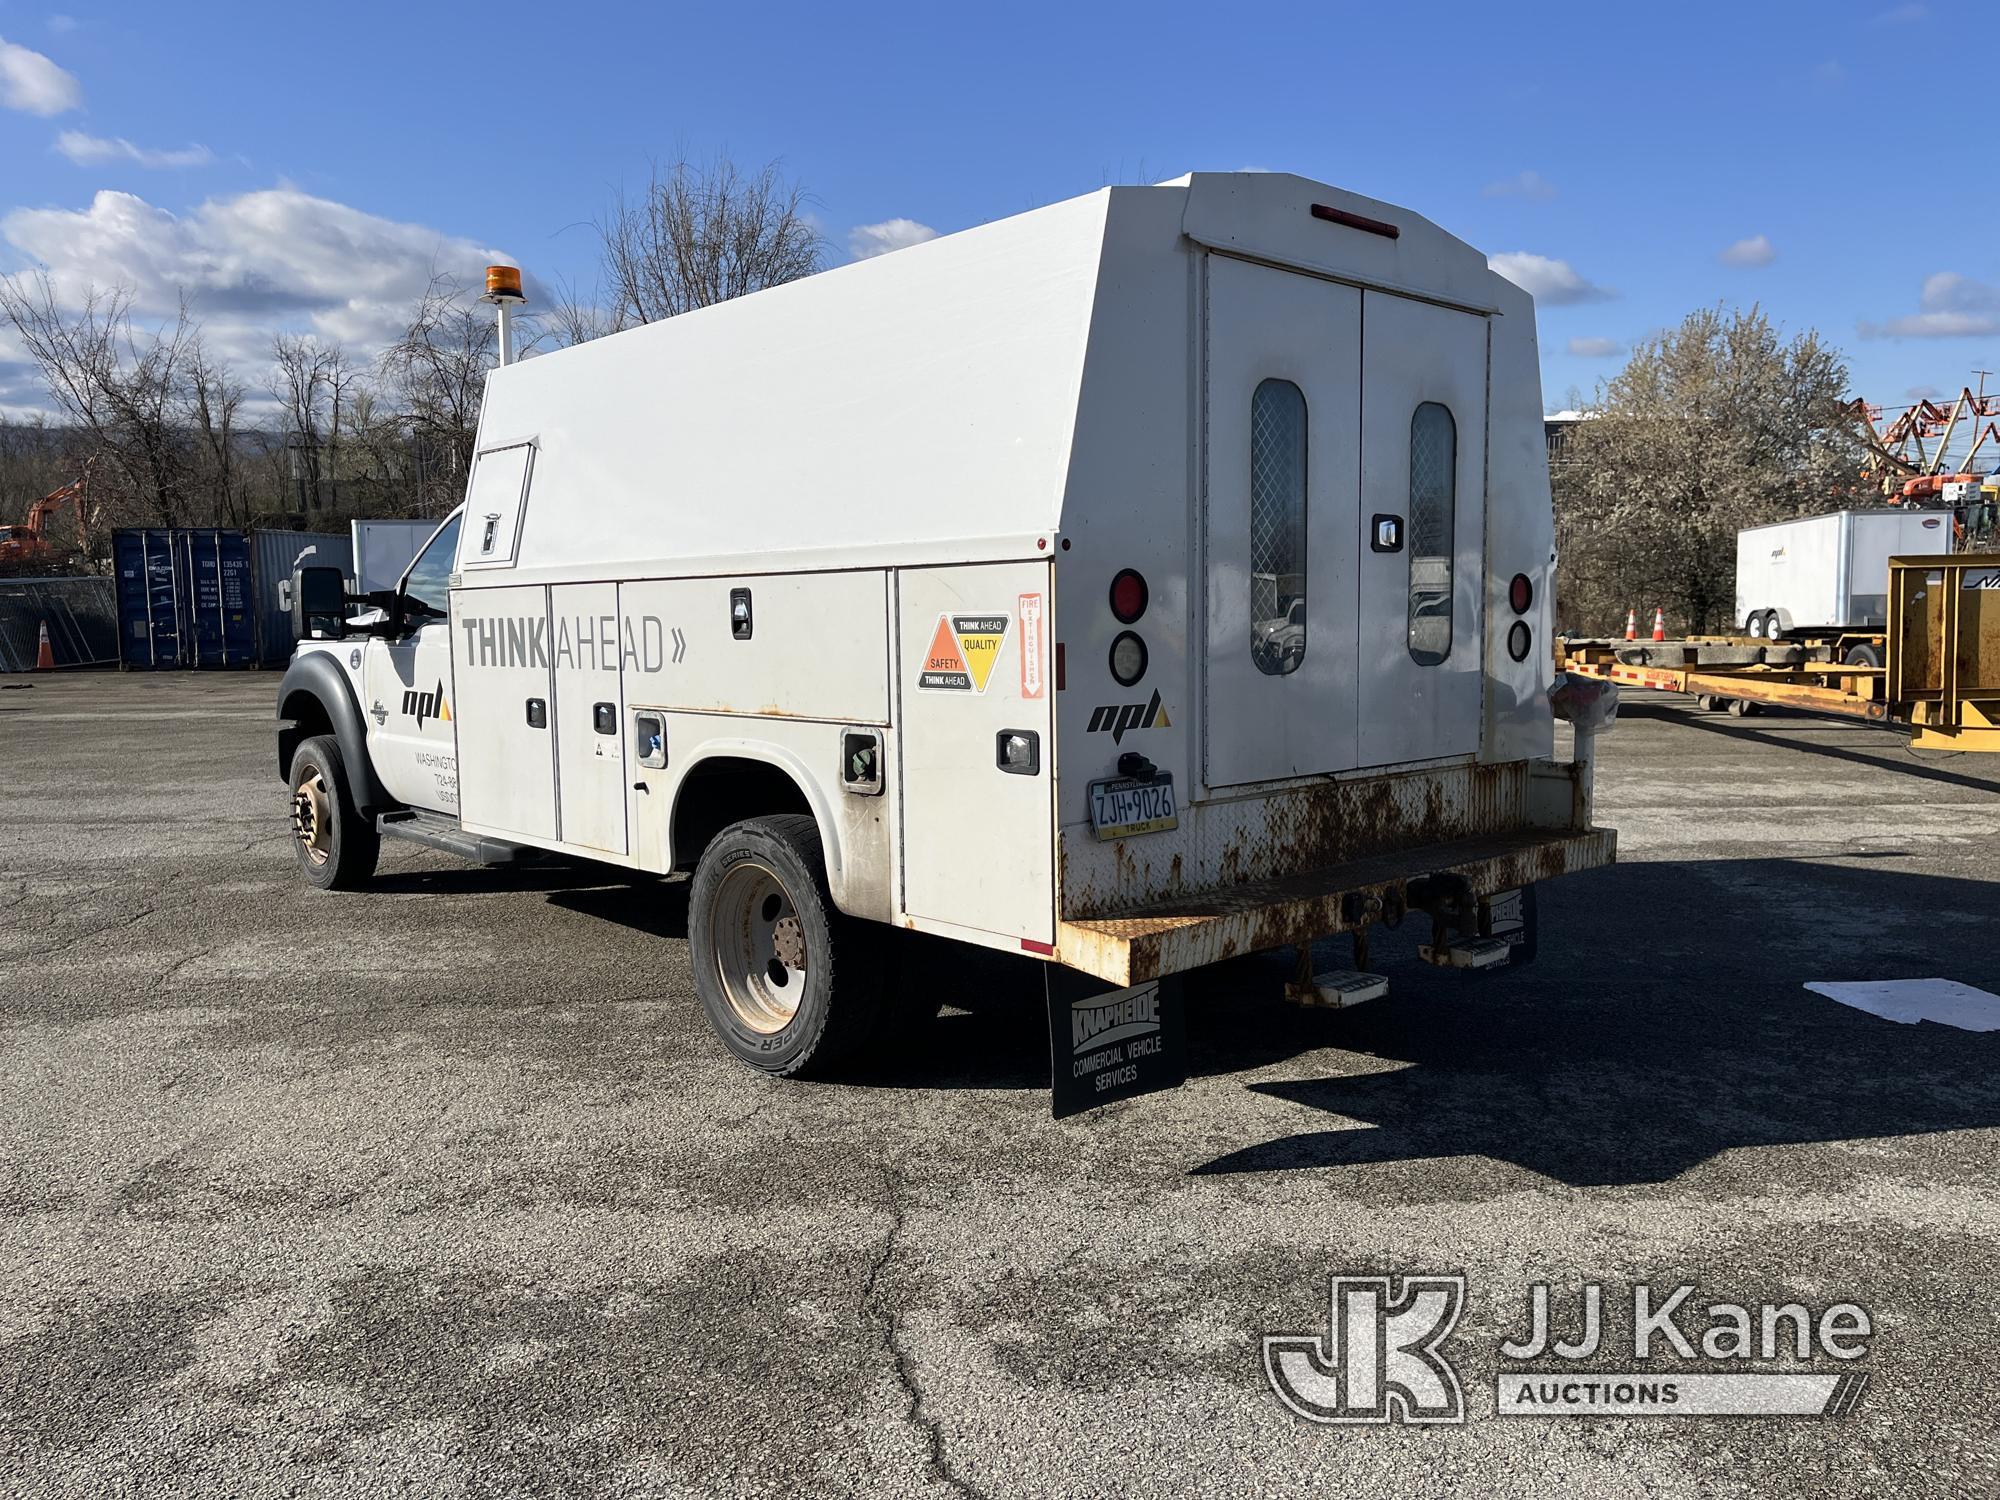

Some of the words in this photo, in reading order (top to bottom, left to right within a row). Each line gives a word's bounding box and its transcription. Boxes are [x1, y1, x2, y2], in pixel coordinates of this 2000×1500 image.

[1021, 599, 1039, 609] FIRE
[959, 621, 979, 631] THINK
[980, 620, 1002, 631] AHEAD
[462, 616, 548, 669] THINK
[556, 615, 663, 673] AHEAD
[964, 639, 997, 651] QUALITY
[930, 658, 959, 669] SAFETY
[924, 675, 944, 685] THINK
[945, 676, 965, 686] AHEAD
[1125, 821, 1152, 832] TRUCK
[721, 849, 750, 866] SERIES
[1072, 986, 1160, 1048] KNAPHEIDE
[1073, 1046, 1123, 1078] COMMERCIAL
[1127, 1036, 1162, 1060] VEHICLE
[1095, 1064, 1138, 1092] SERVICES
